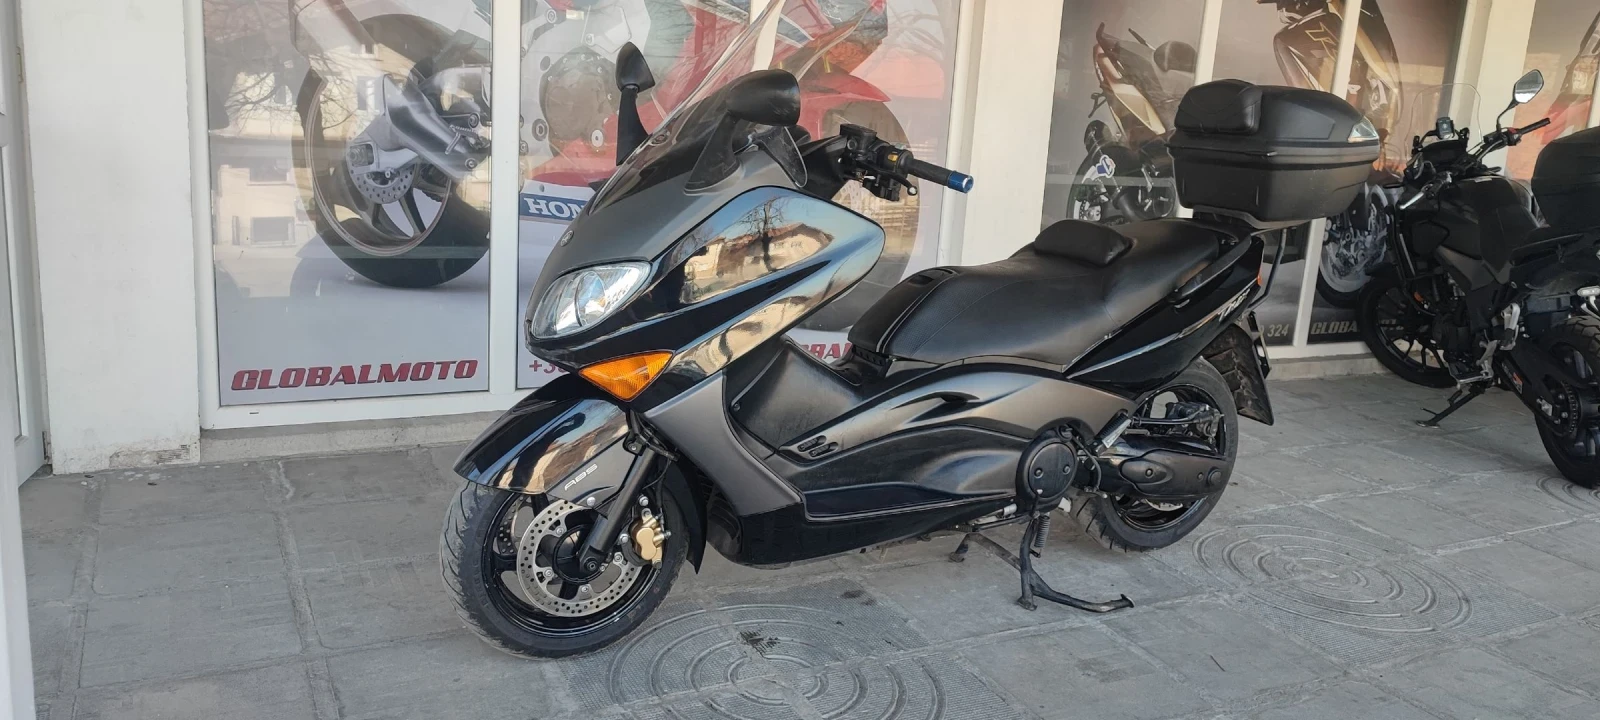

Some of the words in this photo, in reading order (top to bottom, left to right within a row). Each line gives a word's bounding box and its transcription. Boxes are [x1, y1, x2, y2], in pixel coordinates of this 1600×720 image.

[1267, 323, 1290, 338] 324
[231, 359, 479, 391] GLOBALMOTO
[564, 463, 598, 491] ABS
